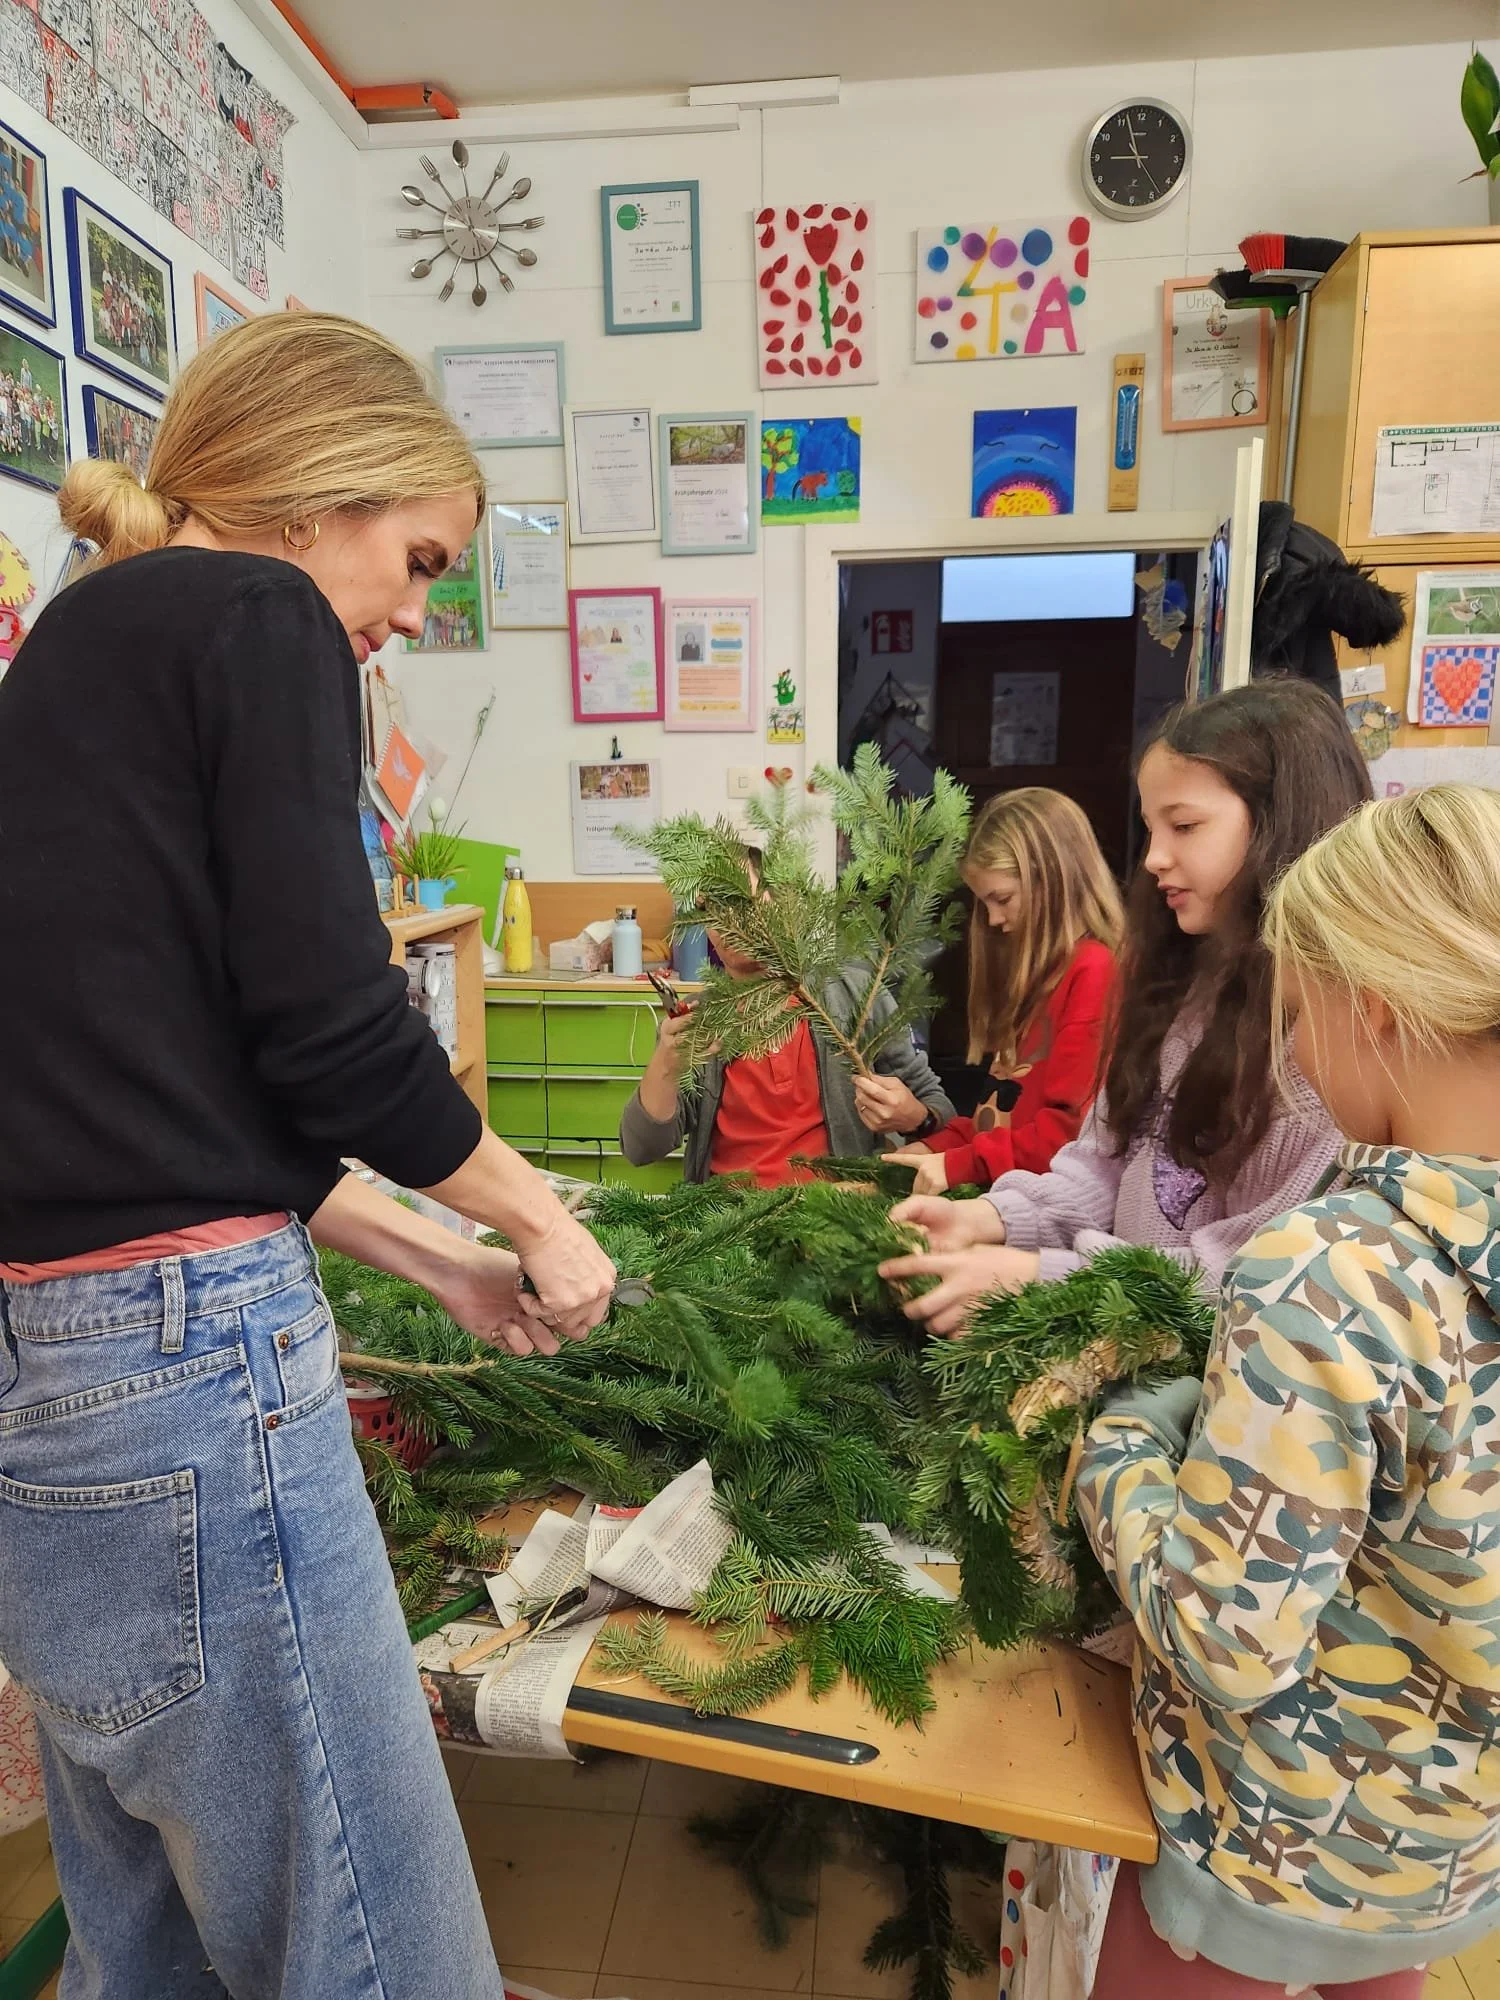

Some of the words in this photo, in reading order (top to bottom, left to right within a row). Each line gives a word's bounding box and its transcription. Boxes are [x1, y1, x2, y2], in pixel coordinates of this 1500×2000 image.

[1137, 113, 1147, 121] 12
[1117, 119, 1126, 127] 11
[1101, 133, 1111, 142] 10
[1170, 134, 1176, 143] 2
[1095, 154, 1101, 162] 9
[1173, 155, 1179, 163] 3
[1097, 175, 1103, 183] 8
[1165, 176, 1171, 185] 4
[1111, 190, 1117, 198] 7
[1149, 191, 1155, 199] 5
[1129, 195, 1135, 204] 6
